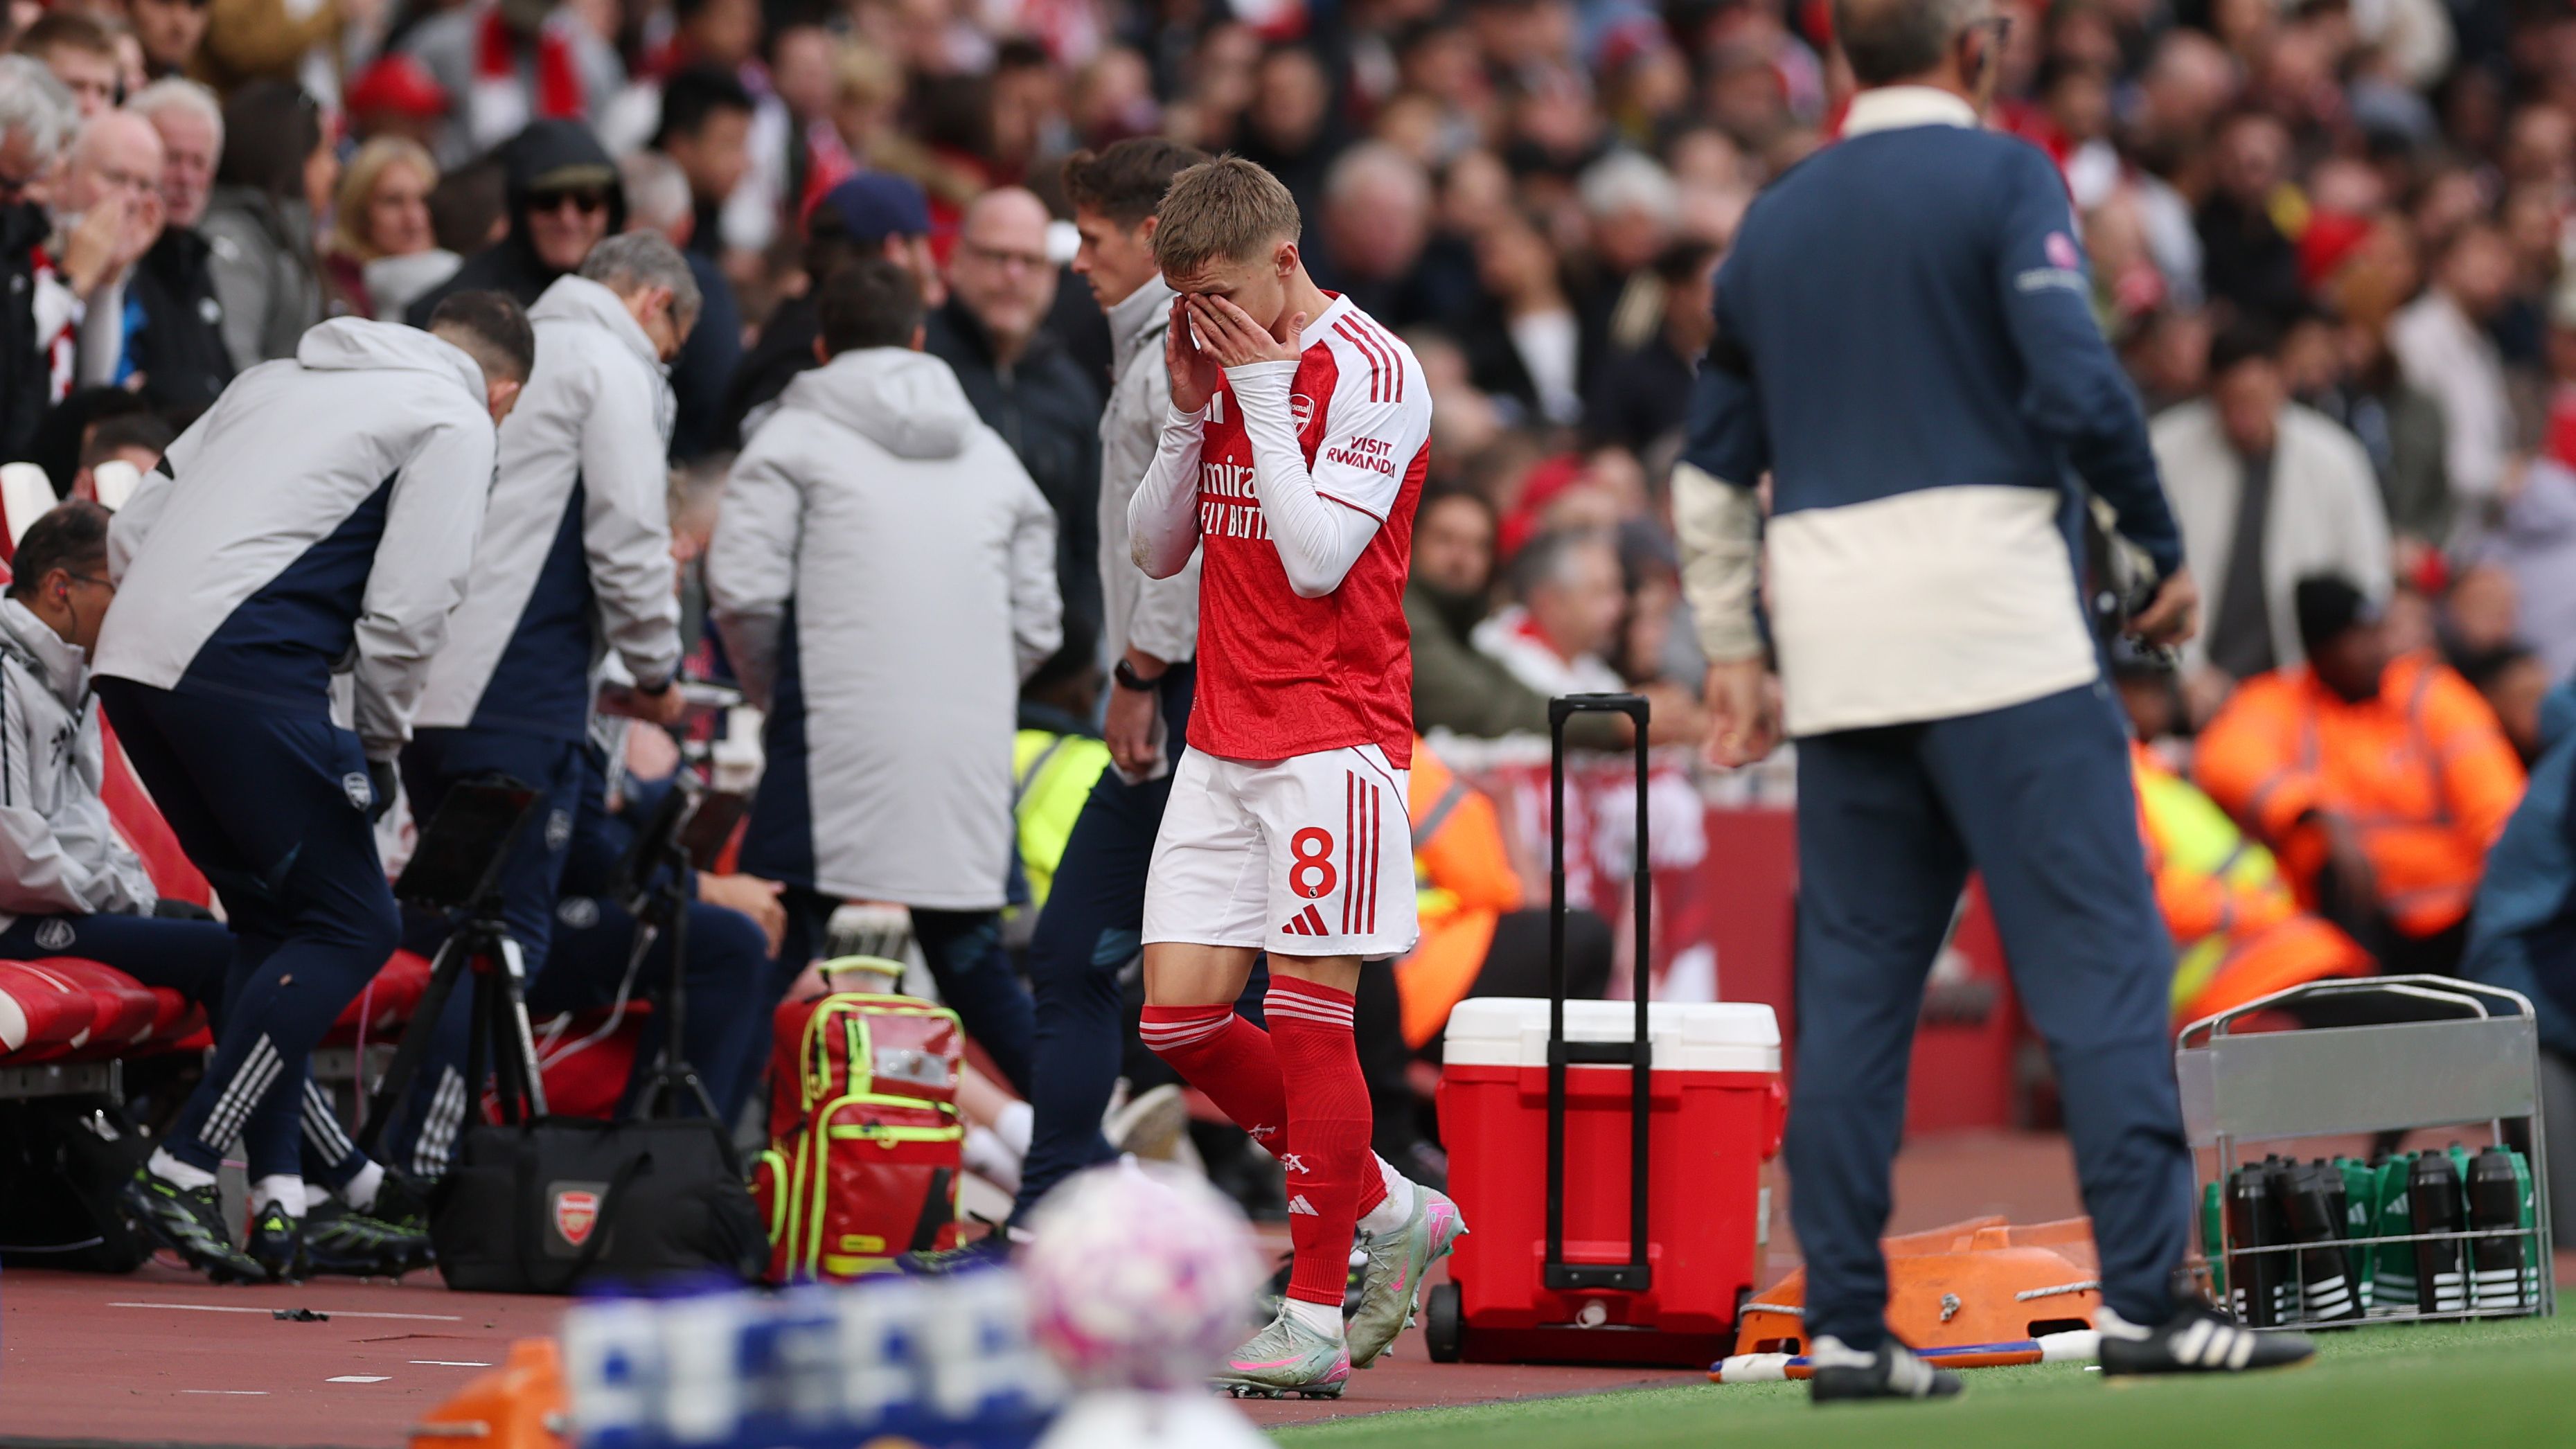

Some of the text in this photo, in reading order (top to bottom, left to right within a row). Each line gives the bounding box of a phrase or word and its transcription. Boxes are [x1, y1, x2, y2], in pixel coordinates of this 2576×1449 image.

[1326, 447, 1396, 479] RWANDA
[1351, 436, 1392, 456] VISIT
[1198, 454, 1258, 499] mira
[1201, 501, 1225, 535] FLY
[1290, 826, 1337, 899] 8
